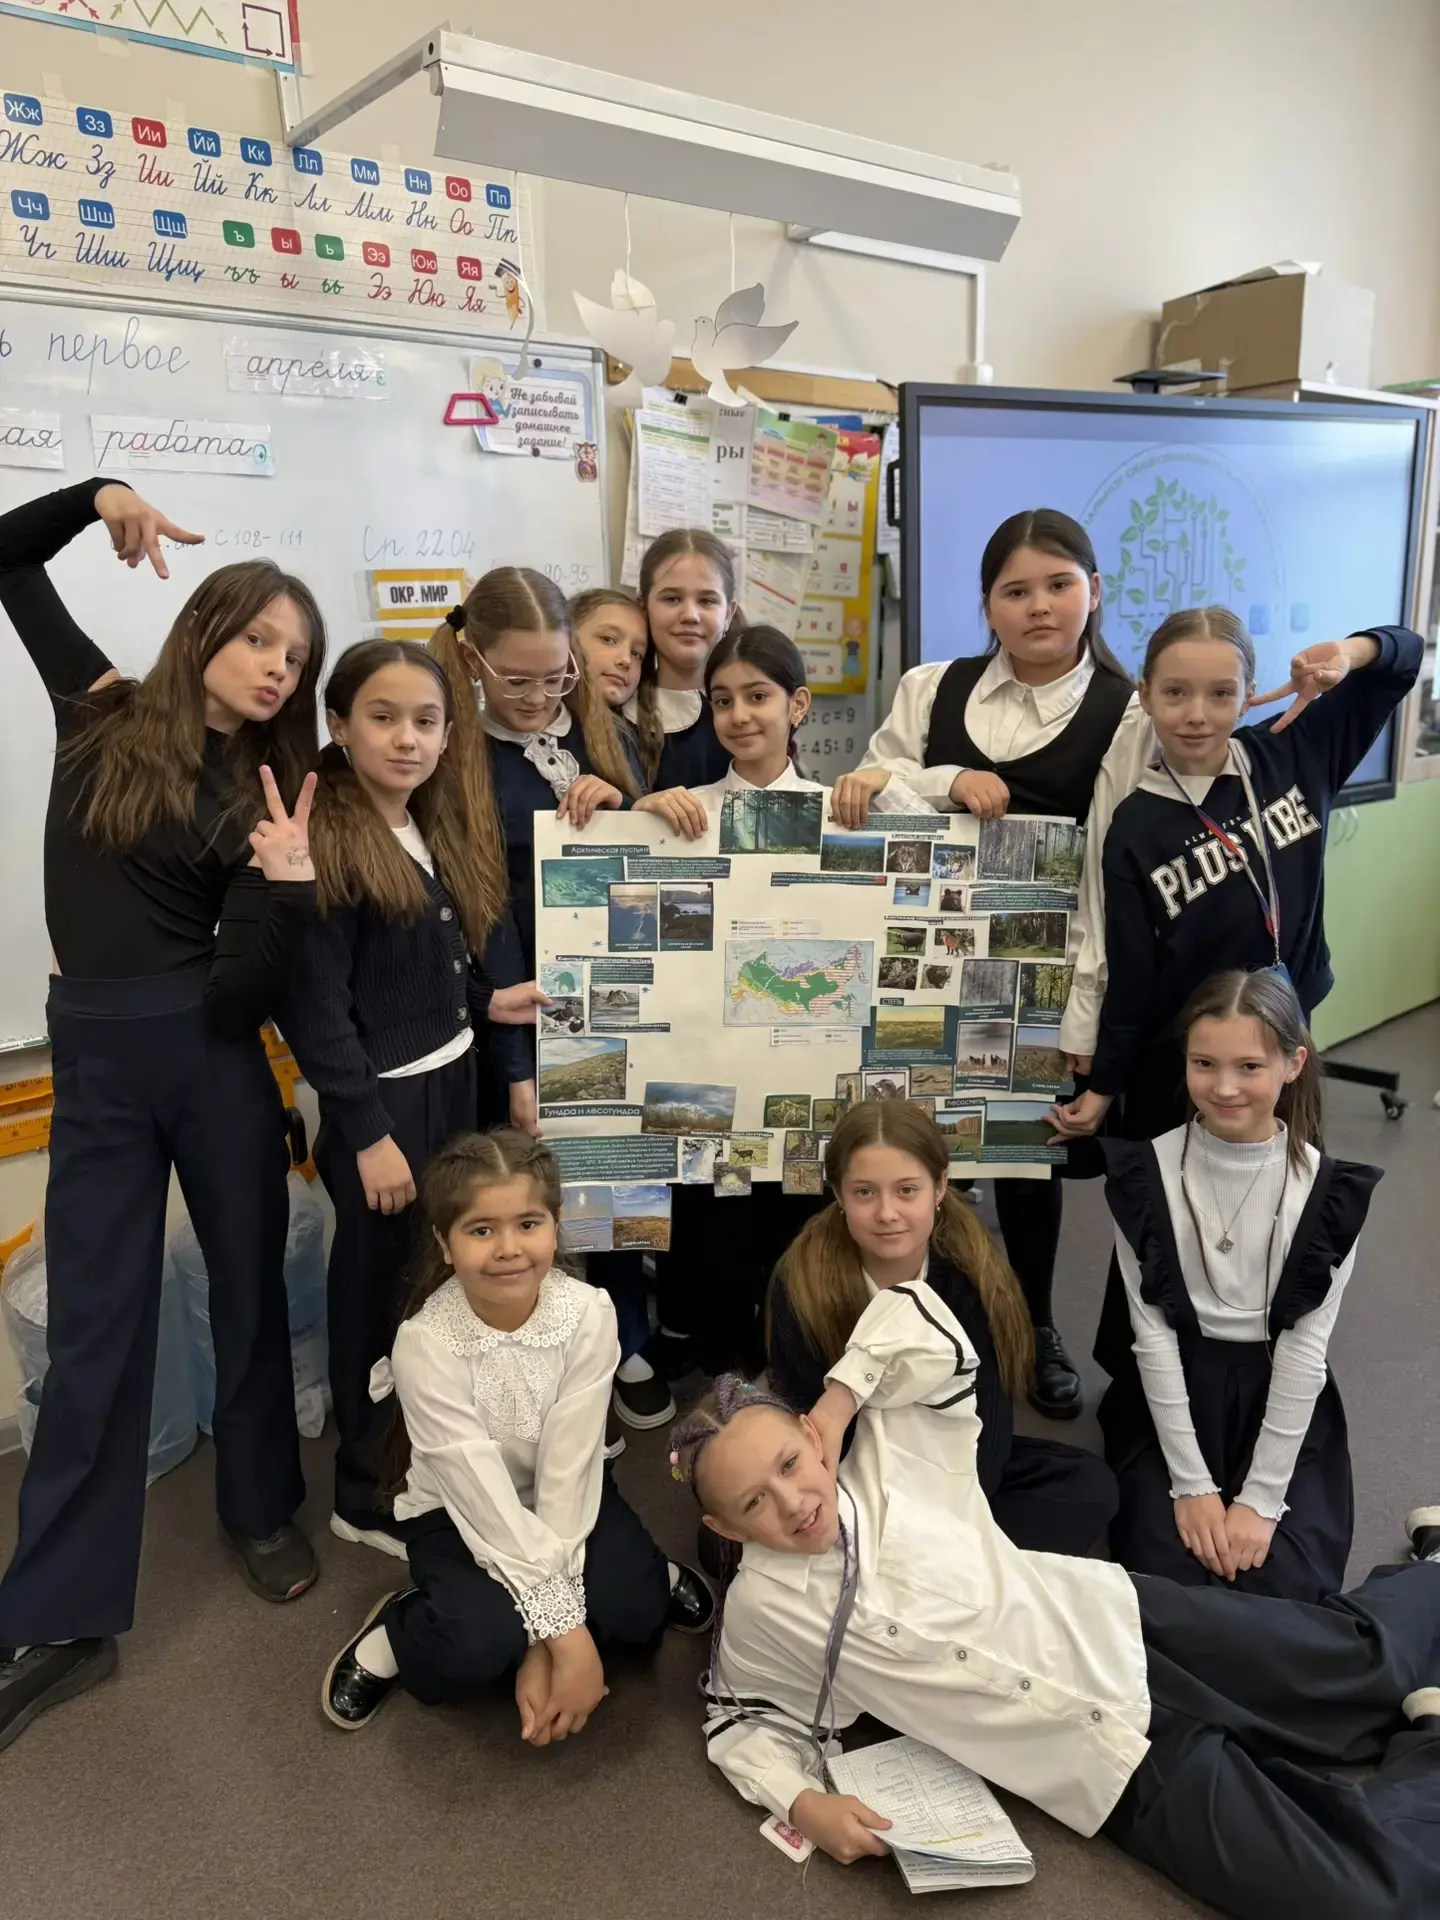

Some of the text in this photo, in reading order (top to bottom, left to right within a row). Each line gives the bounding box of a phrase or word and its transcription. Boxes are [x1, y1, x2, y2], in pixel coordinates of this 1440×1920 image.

[6, 100, 507, 206] Жж Зз Ии Йй Кк Лл Мм Нн Оо Пп
[0, 129, 518, 243] Жж Зз Ии Йй Кк Лл Мм Нн Оо Пп
[18, 197, 44, 215] Чч
[80, 203, 113, 225] Шш
[155, 213, 187, 236] Щщ
[367, 247, 387, 263] Ээ
[411, 253, 437, 271] Юю
[461, 261, 479, 277] Яя
[20, 224, 57, 260] Чч
[75, 232, 130, 269] Шш
[147, 241, 206, 283] Щщ
[367, 272, 393, 300] Ээ
[408, 278, 447, 308] Юю
[458, 286, 487, 313] Яя
[48, 316, 190, 395] первое
[510, 388, 578, 406] Не забывай
[511, 404, 580, 420] записывать
[515, 422, 571, 433] домашнее
[517, 436, 566, 449] задание!
[390, 585, 449, 604] ОКР. МИР
[1150, 832, 1249, 920] PLUS
[544, 1108, 577, 1116] Тундра
